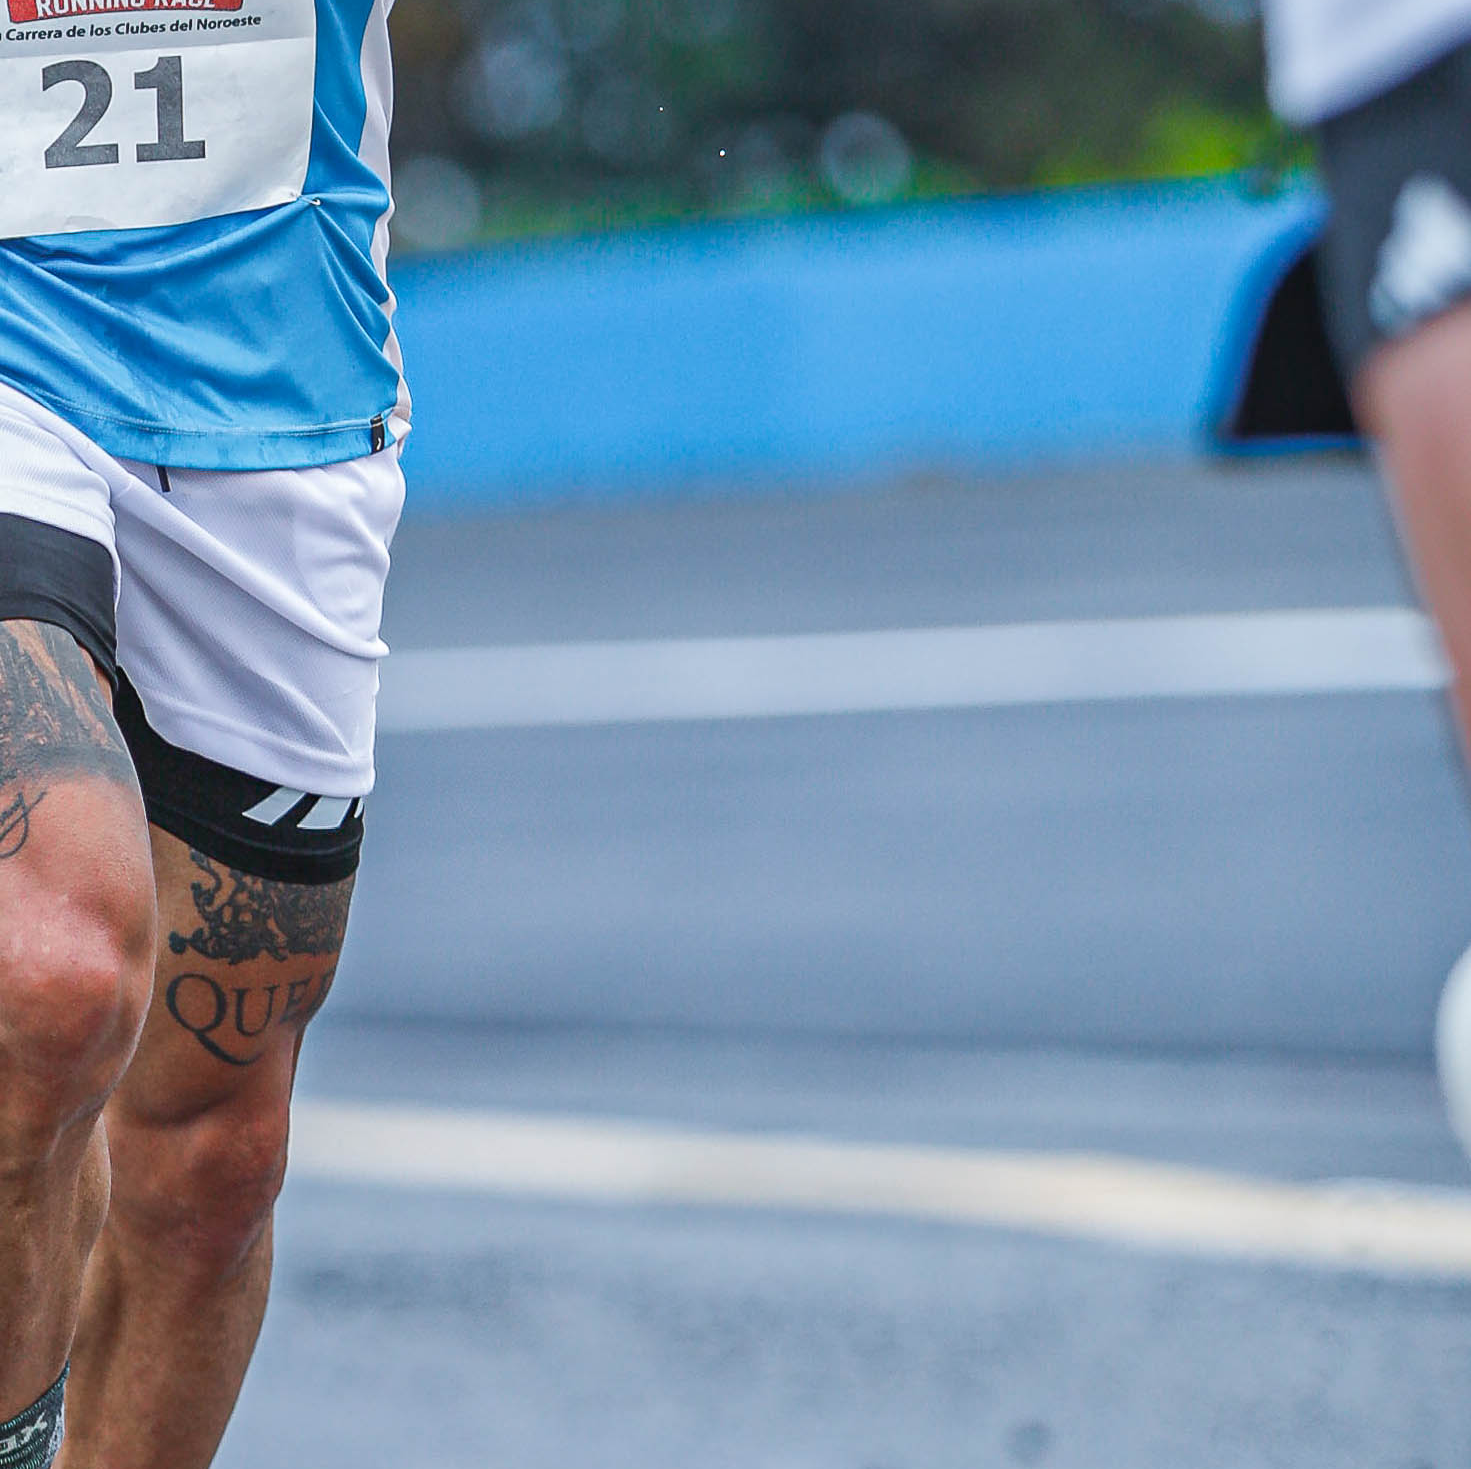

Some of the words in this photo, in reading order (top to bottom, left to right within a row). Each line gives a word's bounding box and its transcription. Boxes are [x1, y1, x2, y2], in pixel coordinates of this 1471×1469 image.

[5, 27, 62, 41] Carrera
[66, 24, 86, 39] de
[89, 22, 112, 37] los
[115, 20, 166, 35] Clubes
[169, 18, 193, 32] del
[196, 14, 262, 31] Noroeste
[41, 55, 206, 170] 21
